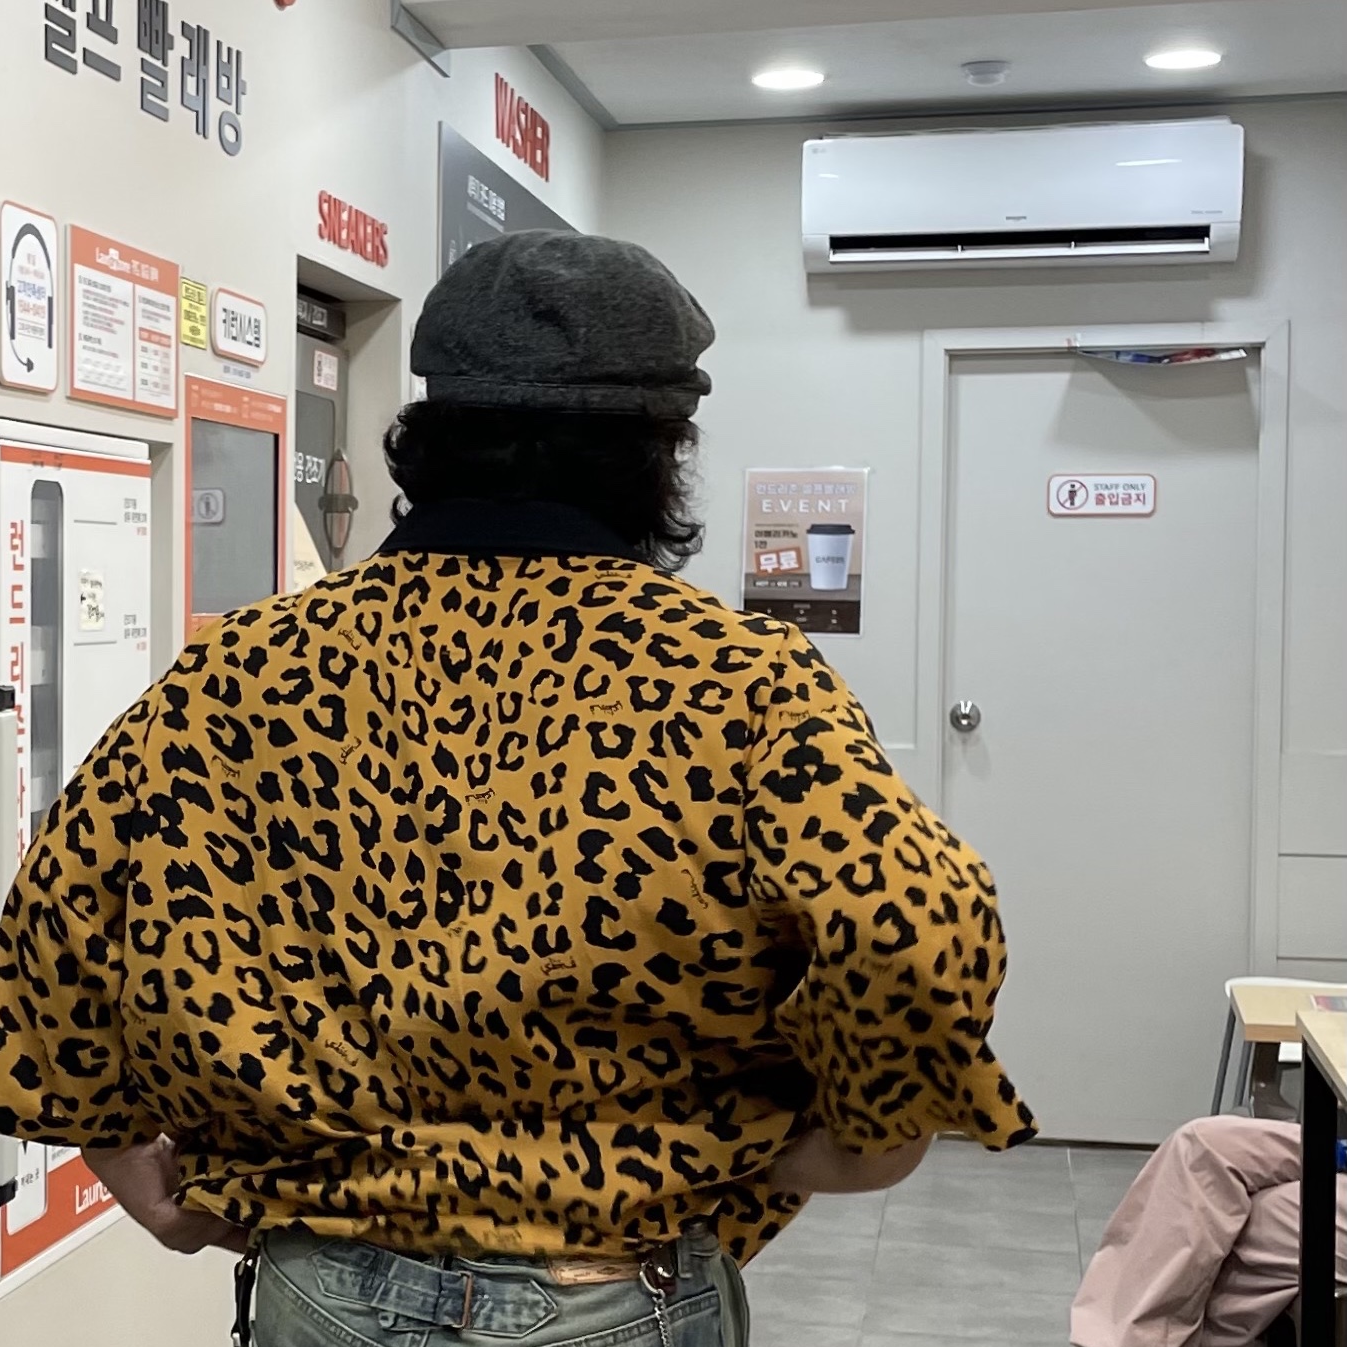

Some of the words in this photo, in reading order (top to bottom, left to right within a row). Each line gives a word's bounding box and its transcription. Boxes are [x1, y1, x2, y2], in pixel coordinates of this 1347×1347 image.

[137, 0, 248, 157] 빨래방
[494, 72, 551, 183] WASHER
[318, 190, 388, 268] SNEAKERS
[1094, 483, 1120, 491] STAFF
[1122, 483, 1147, 491] ONLY
[1095, 493, 1146, 506] 출입금지
